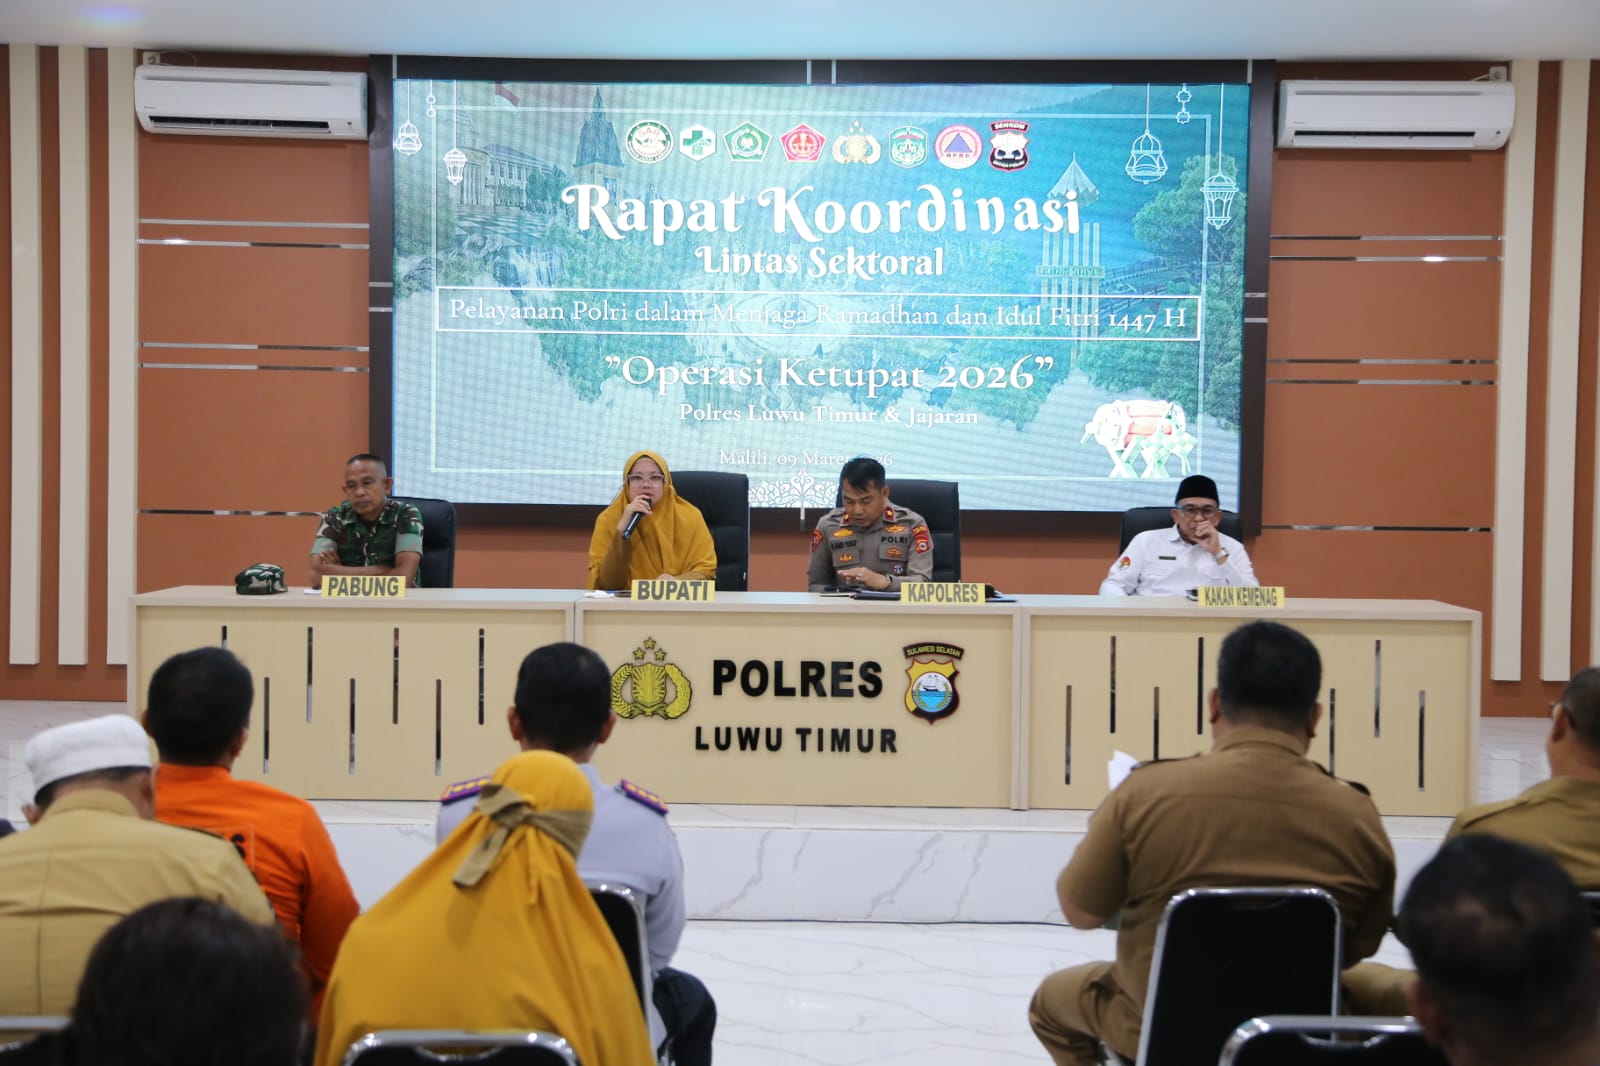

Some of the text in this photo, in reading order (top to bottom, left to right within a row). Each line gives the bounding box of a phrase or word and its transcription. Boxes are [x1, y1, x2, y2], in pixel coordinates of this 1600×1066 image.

[561, 184, 1081, 245] Rapat Koordinasi
[694, 245, 944, 281] Lintas Sektoral
[449, 299, 1186, 333] Pelayanan Polri dalam Menjaga Ramadhan dan Idul Fitri 1447 H
[779, 358, 926, 398] Ketupat
[679, 403, 979, 429] Polres Luwu Timur & Jajaran
[719, 449, 772, 467] Malili,
[777, 455, 797, 467] 09
[857, 451, 894, 466] 26
[881, 536, 908, 544] POLRI
[328, 577, 399, 596] PABUNG
[638, 581, 708, 600] BUPATI
[908, 584, 979, 602] KAPOLRES
[1205, 587, 1277, 606] KAKAN KEMENAG
[906, 645, 961, 657] SULAWESI SELATAN
[713, 660, 883, 698] POLRES
[695, 726, 898, 753] LUWU TIMUR
